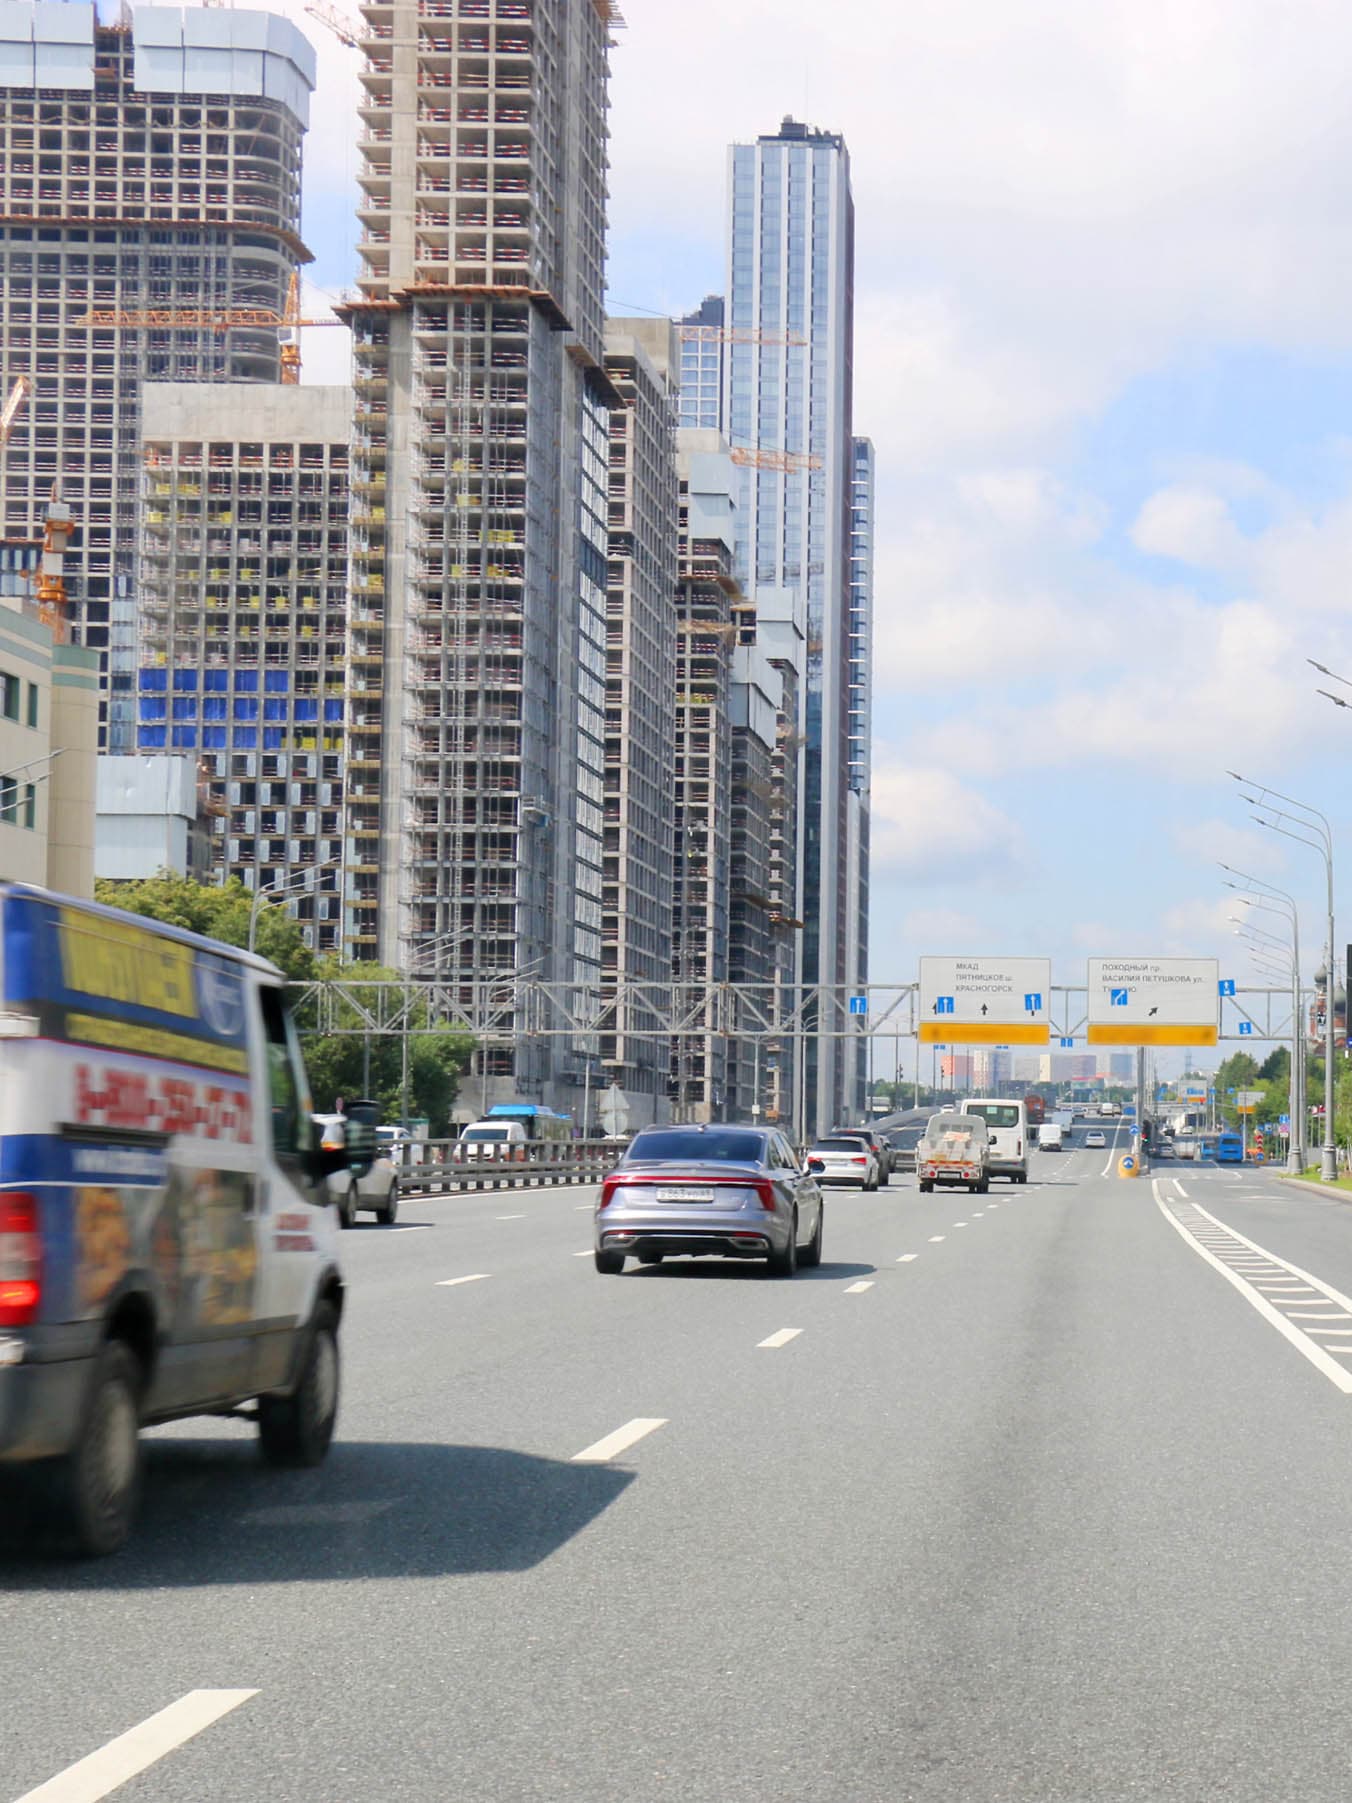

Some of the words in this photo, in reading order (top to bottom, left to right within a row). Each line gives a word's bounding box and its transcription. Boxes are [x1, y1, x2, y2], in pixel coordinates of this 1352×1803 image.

[956, 963, 979, 971] МКАД
[1102, 963, 1149, 972] ПОХОДНЫЙ
[956, 974, 1004, 982] ПЯТНИЦКОЕ
[1102, 974, 1141, 983] ВАСИЛИЯ
[1142, 975, 1192, 983] ПЕТУШКОВА
[956, 985, 1014, 993] КРАСНОГОРСК
